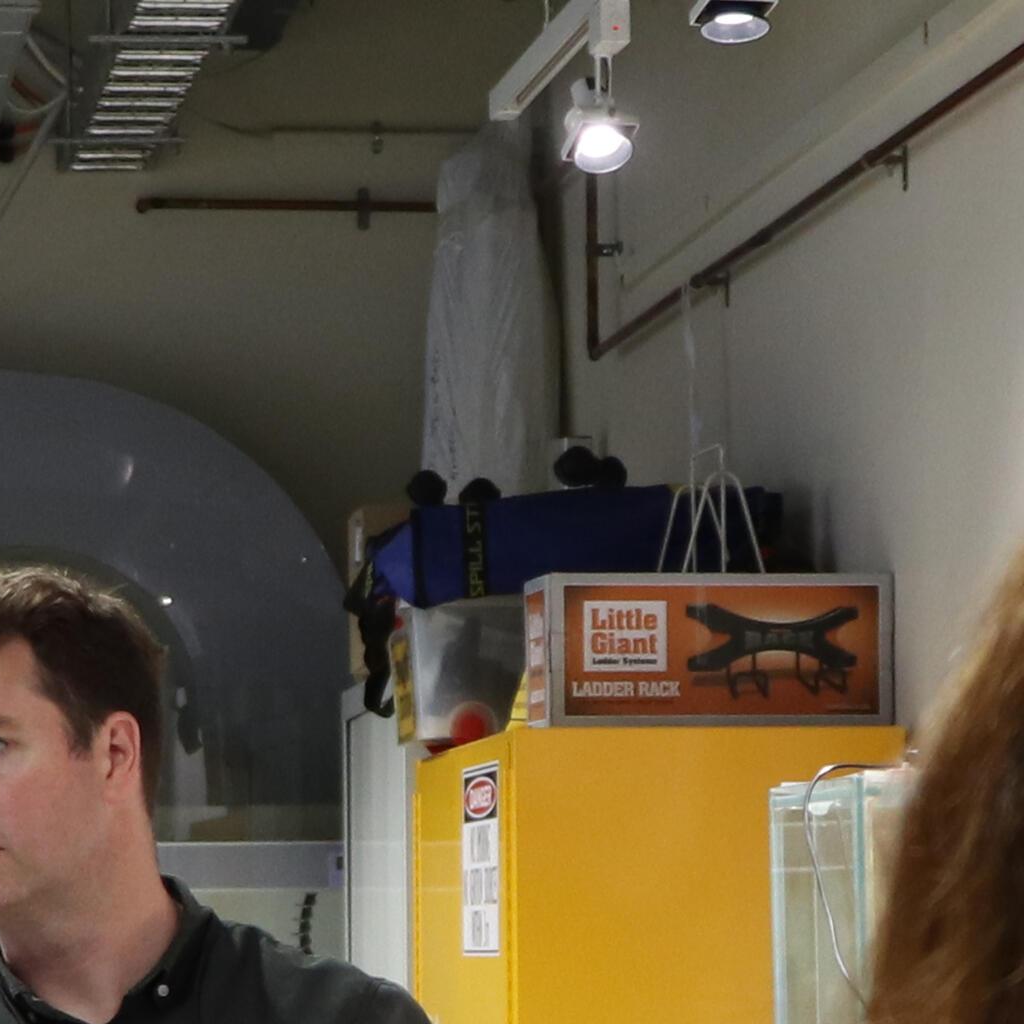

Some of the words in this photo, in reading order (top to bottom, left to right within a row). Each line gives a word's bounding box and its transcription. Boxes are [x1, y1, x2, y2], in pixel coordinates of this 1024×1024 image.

[469, 540, 485, 597] SPILL
[591, 608, 658, 631] Little
[591, 632, 658, 655] Giant
[592, 657, 620, 665] Ladder
[622, 657, 657, 667] Systems
[572, 681, 634, 698] LADDER
[638, 681, 681, 697] RACK
